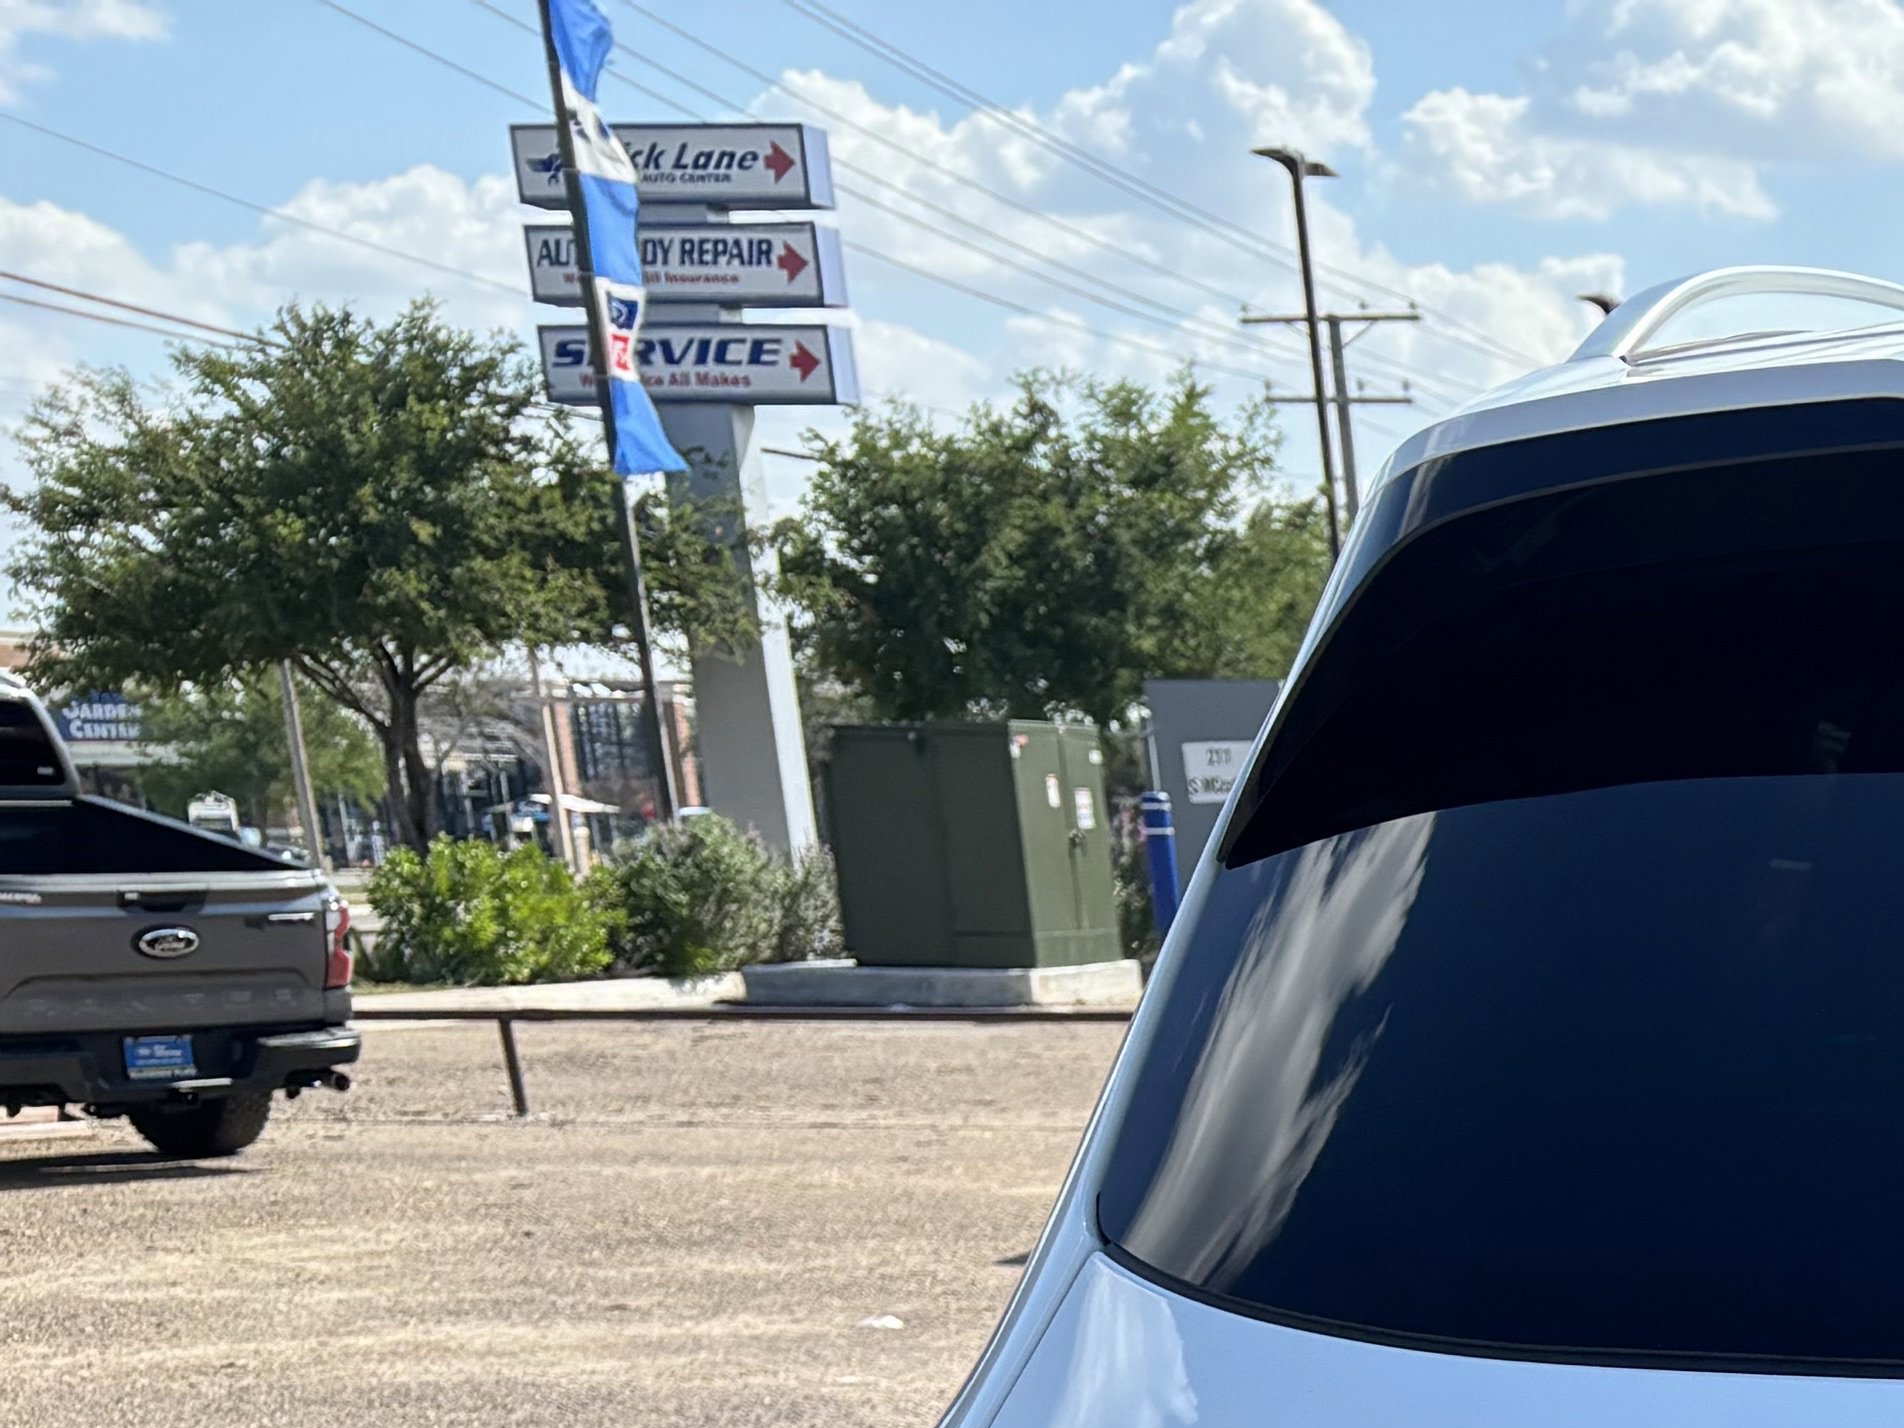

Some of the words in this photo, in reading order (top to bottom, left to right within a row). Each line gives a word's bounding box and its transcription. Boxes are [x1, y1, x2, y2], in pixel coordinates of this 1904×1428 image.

[671, 140, 760, 171] Lane
[641, 171, 676, 184] AUTO
[679, 171, 732, 184] CENTER
[679, 238, 775, 267] REPAIR
[664, 271, 740, 284] Insurance
[552, 337, 784, 368] SRVICE
[668, 372, 691, 387] All
[694, 372, 753, 388] Makes
